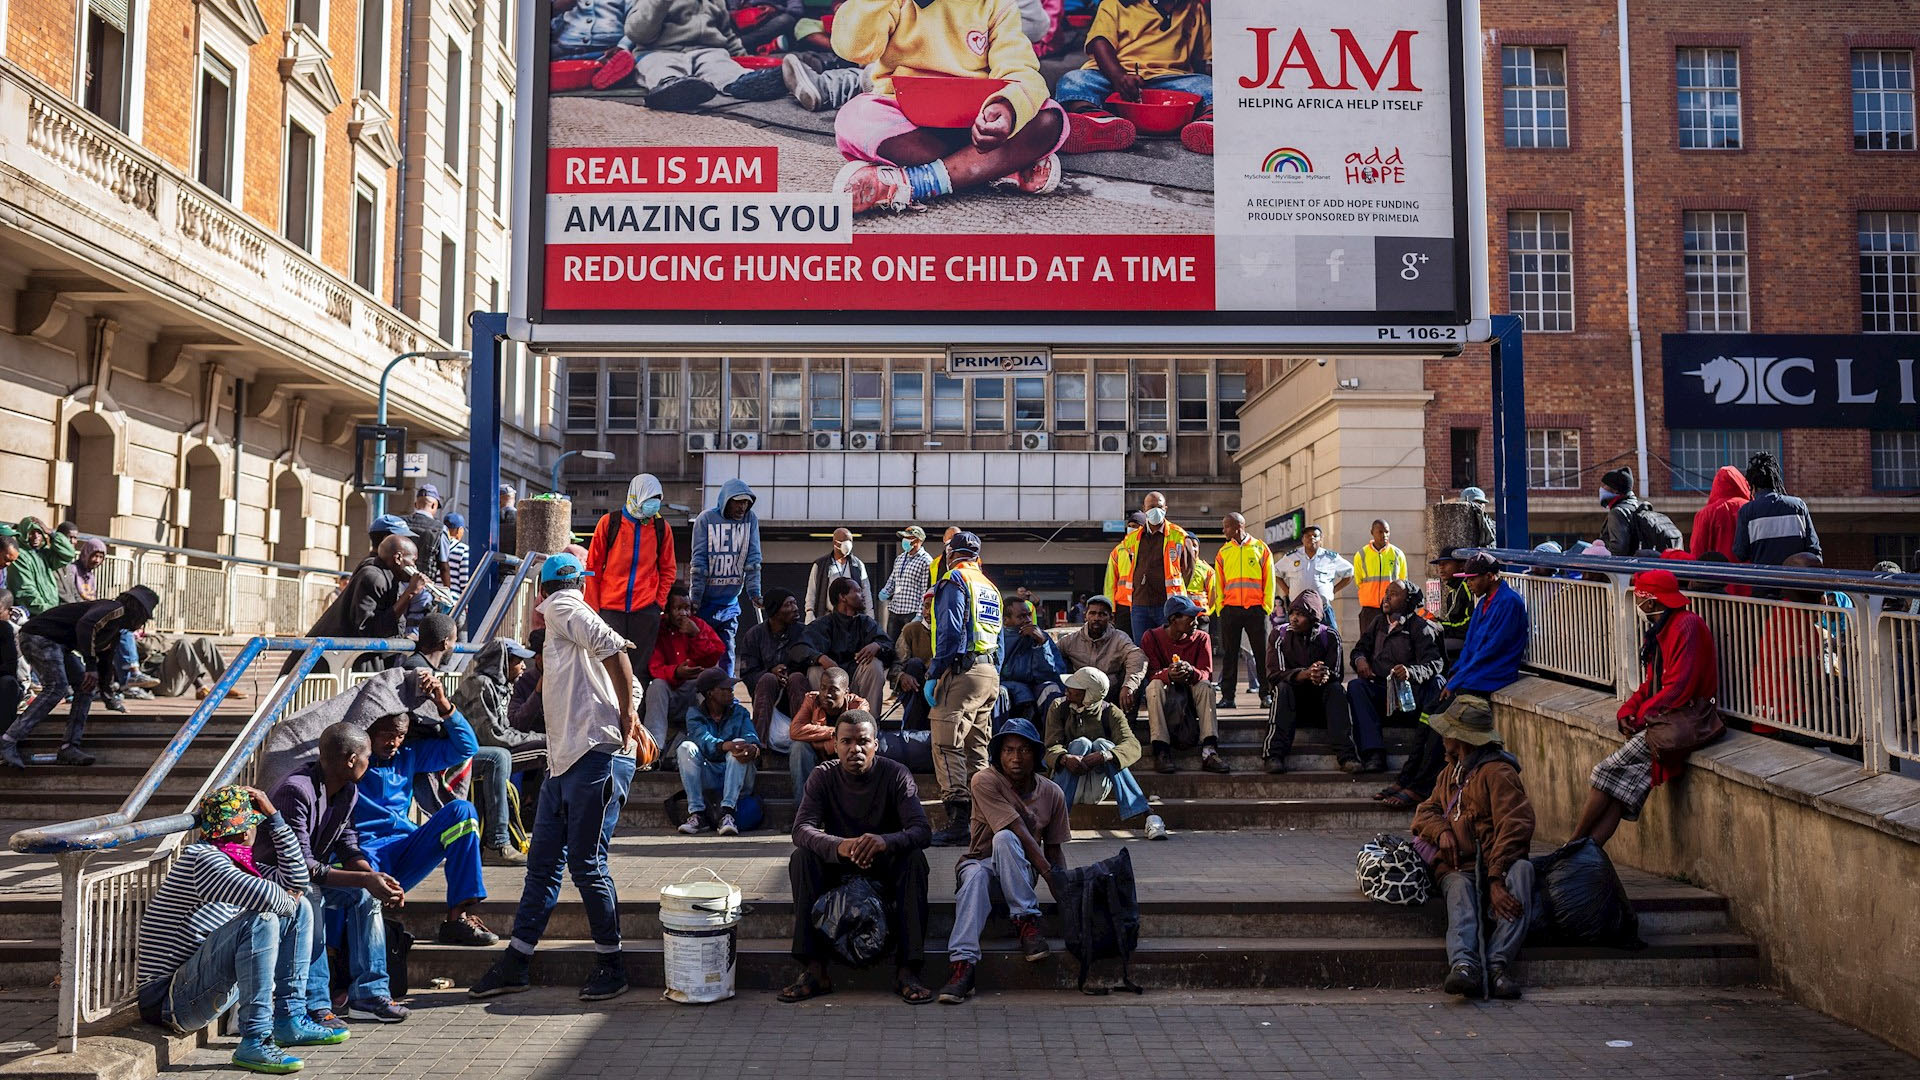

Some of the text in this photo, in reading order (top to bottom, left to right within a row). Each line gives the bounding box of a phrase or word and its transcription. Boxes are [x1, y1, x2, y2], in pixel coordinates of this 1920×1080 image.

[1238, 27, 1423, 91] JAM
[1238, 98, 1424, 111] HELPING AFRICA HELP ITSELF
[1344, 146, 1404, 165] add
[565, 156, 763, 185] REAL IS JAM
[1247, 199, 1420, 209] A RECIPIENT OF ADD HOPE FUNDING
[564, 205, 839, 232] AMAZING IS YOU
[1248, 212, 1420, 223] PROUDLY SPONSORED BY PRIMEDIA
[564, 255, 1196, 282] REDUCING HUNGER ONE CHILD AT A TIME
[1378, 328, 1457, 339] PL 106-2
[388, 455, 424, 463] PICE
[708, 523, 751, 552] NEW
[708, 554, 746, 576] YORK
